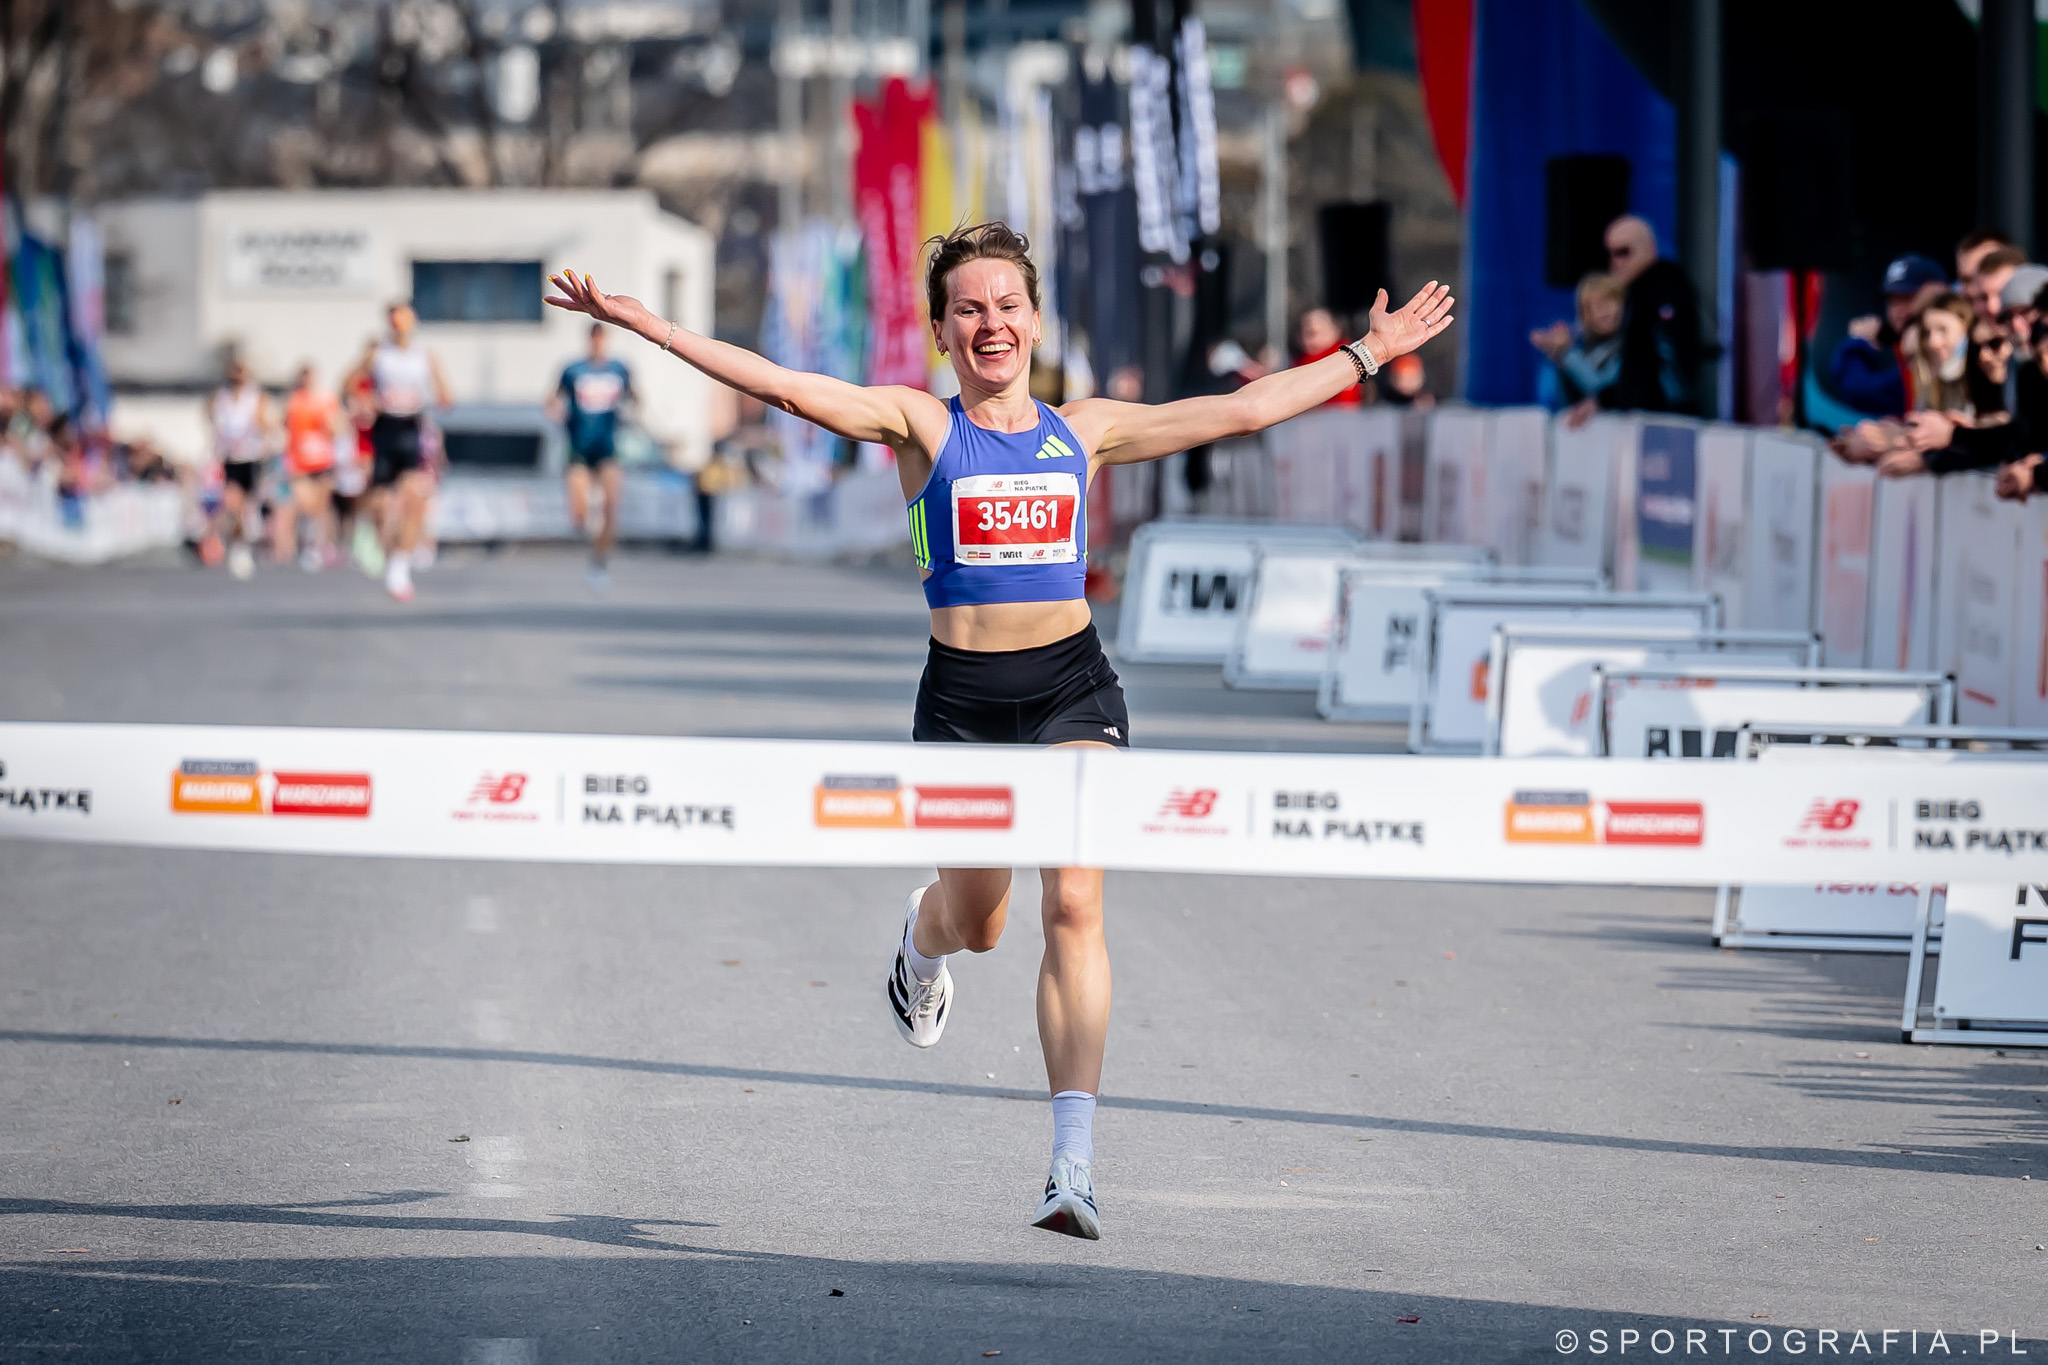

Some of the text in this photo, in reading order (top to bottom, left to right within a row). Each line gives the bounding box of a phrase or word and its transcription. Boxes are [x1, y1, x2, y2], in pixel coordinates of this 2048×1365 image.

[977, 499, 1059, 532] 35461
[582, 774, 650, 794] BIEG
[1273, 790, 1340, 810] BIEG
[1914, 799, 1982, 820] BIEG
[583, 804, 735, 831] NA PIĄTKĘ
[1273, 820, 1426, 846] NA PIĄTKĘ
[1914, 829, 1954, 849] NA
